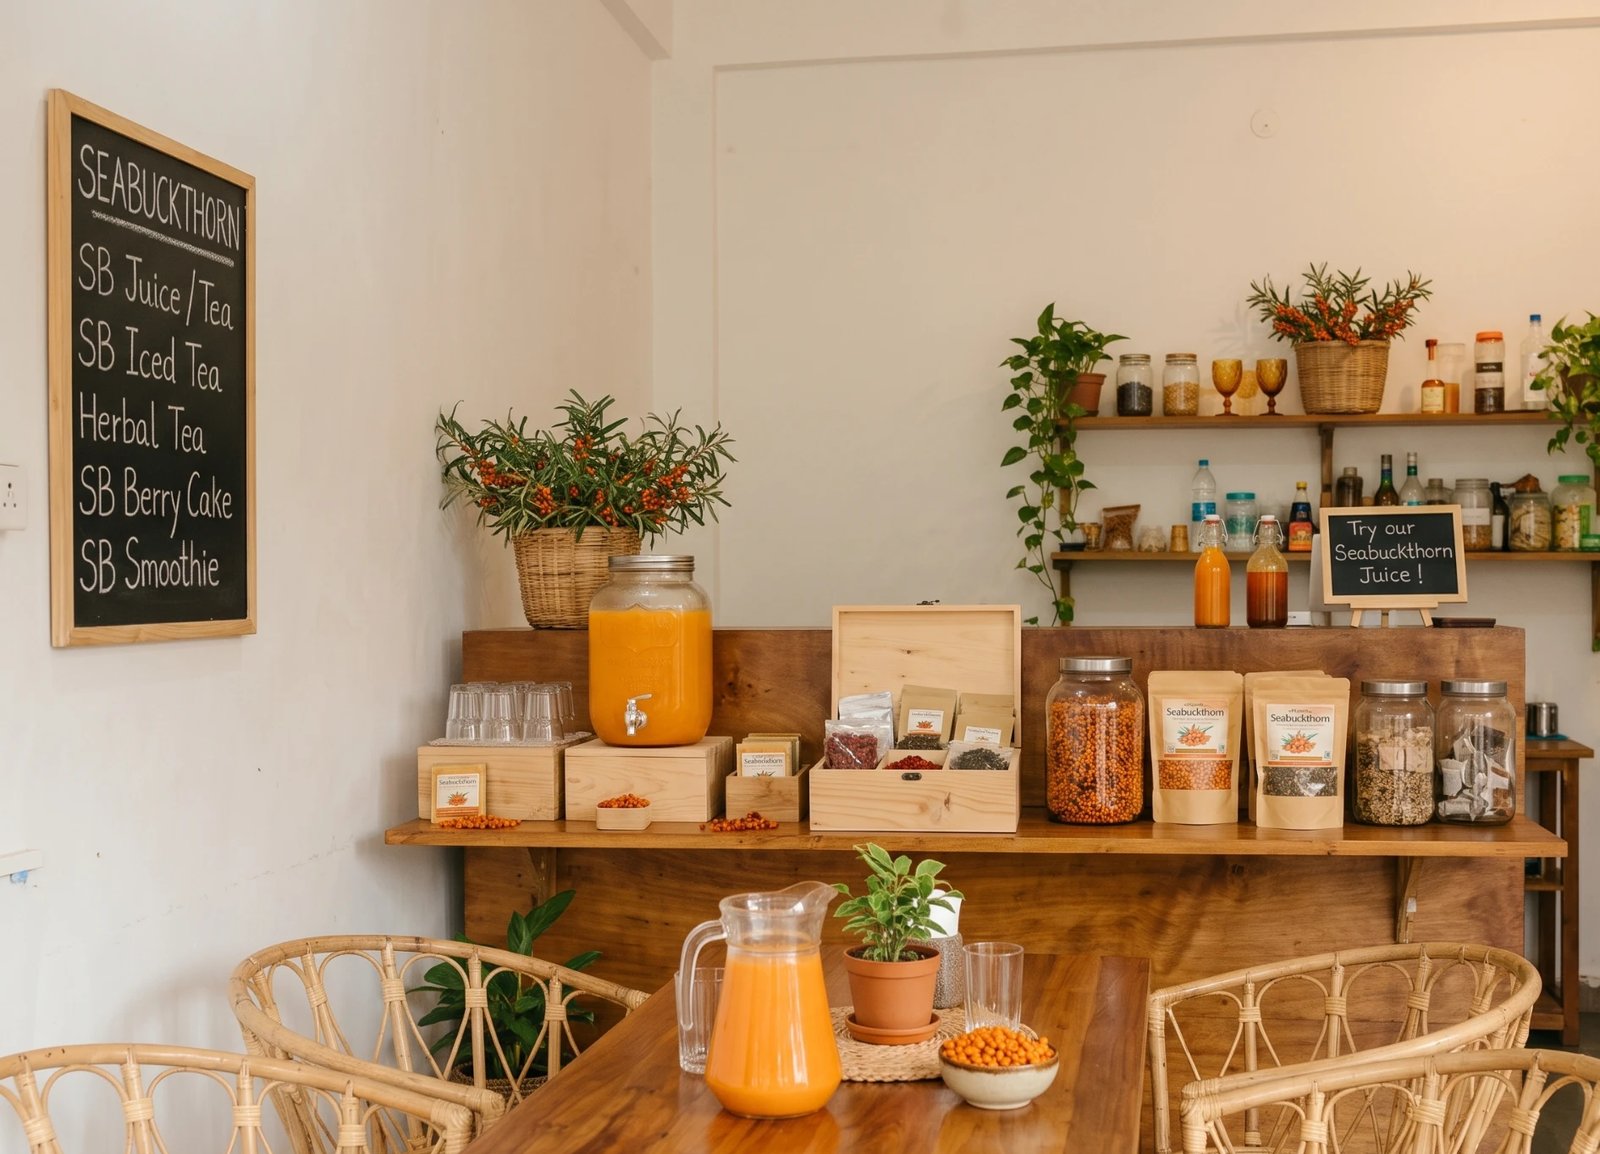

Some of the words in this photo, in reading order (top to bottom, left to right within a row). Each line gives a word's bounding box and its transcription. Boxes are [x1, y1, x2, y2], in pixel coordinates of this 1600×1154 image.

[78, 144, 240, 250] SEABUCKTHORN
[78, 242, 115, 296] SB
[78, 318, 115, 371] SB
[125, 326, 176, 384] Iced
[185, 341, 223, 392] Tea
[79, 392, 160, 449] Herbal
[168, 405, 207, 454] Tea
[79, 465, 115, 516] SB
[124, 466, 181, 539] Berry
[187, 471, 233, 519] Cake
[1335, 542, 1453, 562] Seabuckthorn
[1346, 520, 1377, 543] Try
[1385, 523, 1416, 535] our
[79, 539, 116, 594] SB
[124, 536, 220, 589] Smoothie
[1166, 708, 1224, 716] Seabuckthorn
[1271, 713, 1330, 722] Seabuckthorn
